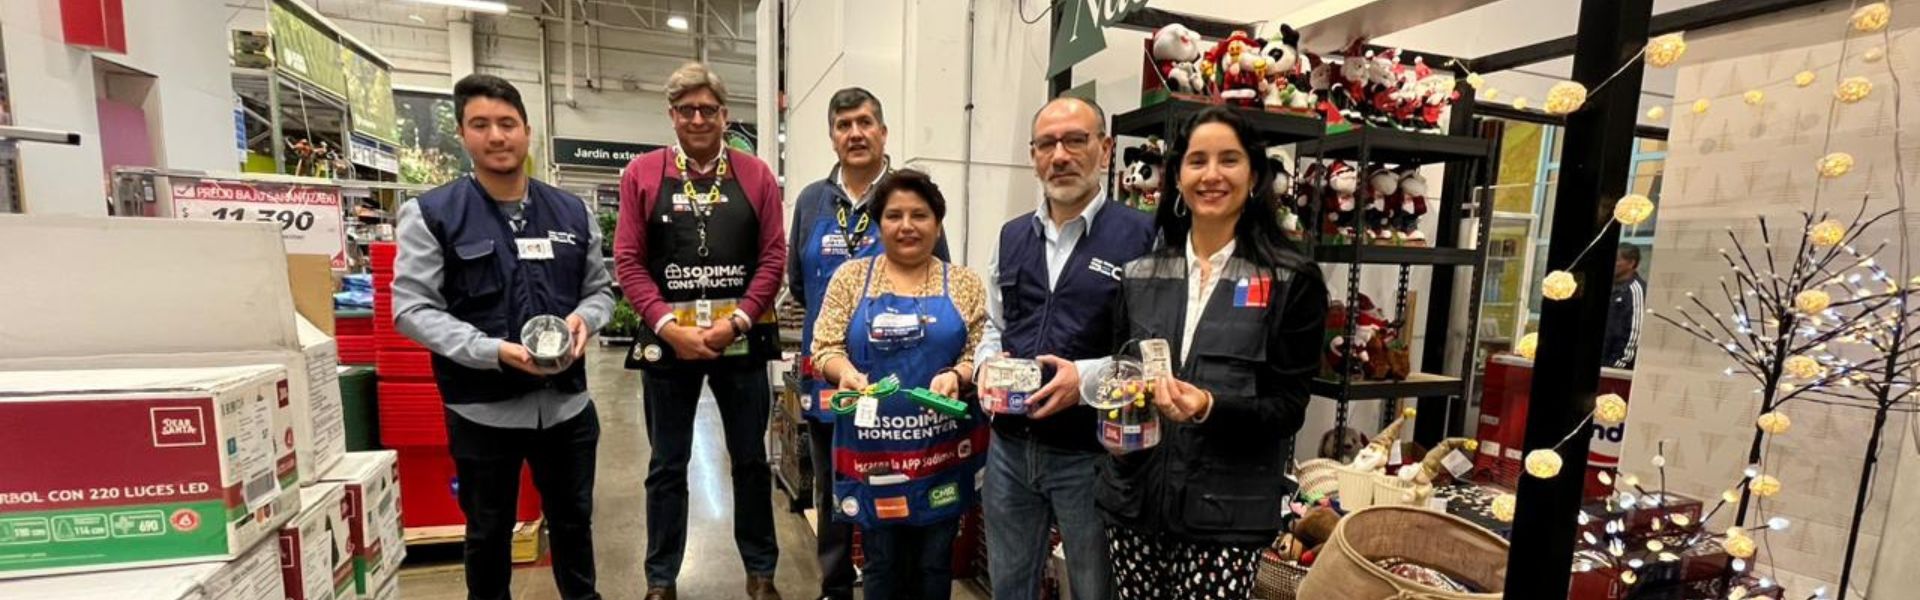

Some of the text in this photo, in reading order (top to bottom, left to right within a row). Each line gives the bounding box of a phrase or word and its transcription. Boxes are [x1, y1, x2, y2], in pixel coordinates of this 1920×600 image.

[197, 187, 234, 199] PRECIO
[235, 189, 265, 201] BAJO
[683, 264, 746, 278] SODIMAC
[1088, 257, 1123, 281] SEC
[162, 418, 192, 427] DEAR
[161, 426, 197, 436] SANTA
[857, 419, 958, 441] HOMECENTER
[891, 458, 900, 470] la
[902, 458, 921, 472] APP
[48, 489, 84, 502] CON
[89, 487, 120, 500] 220
[124, 484, 175, 498] LUCES
[179, 482, 210, 494] LED
[931, 486, 955, 500] CMR
